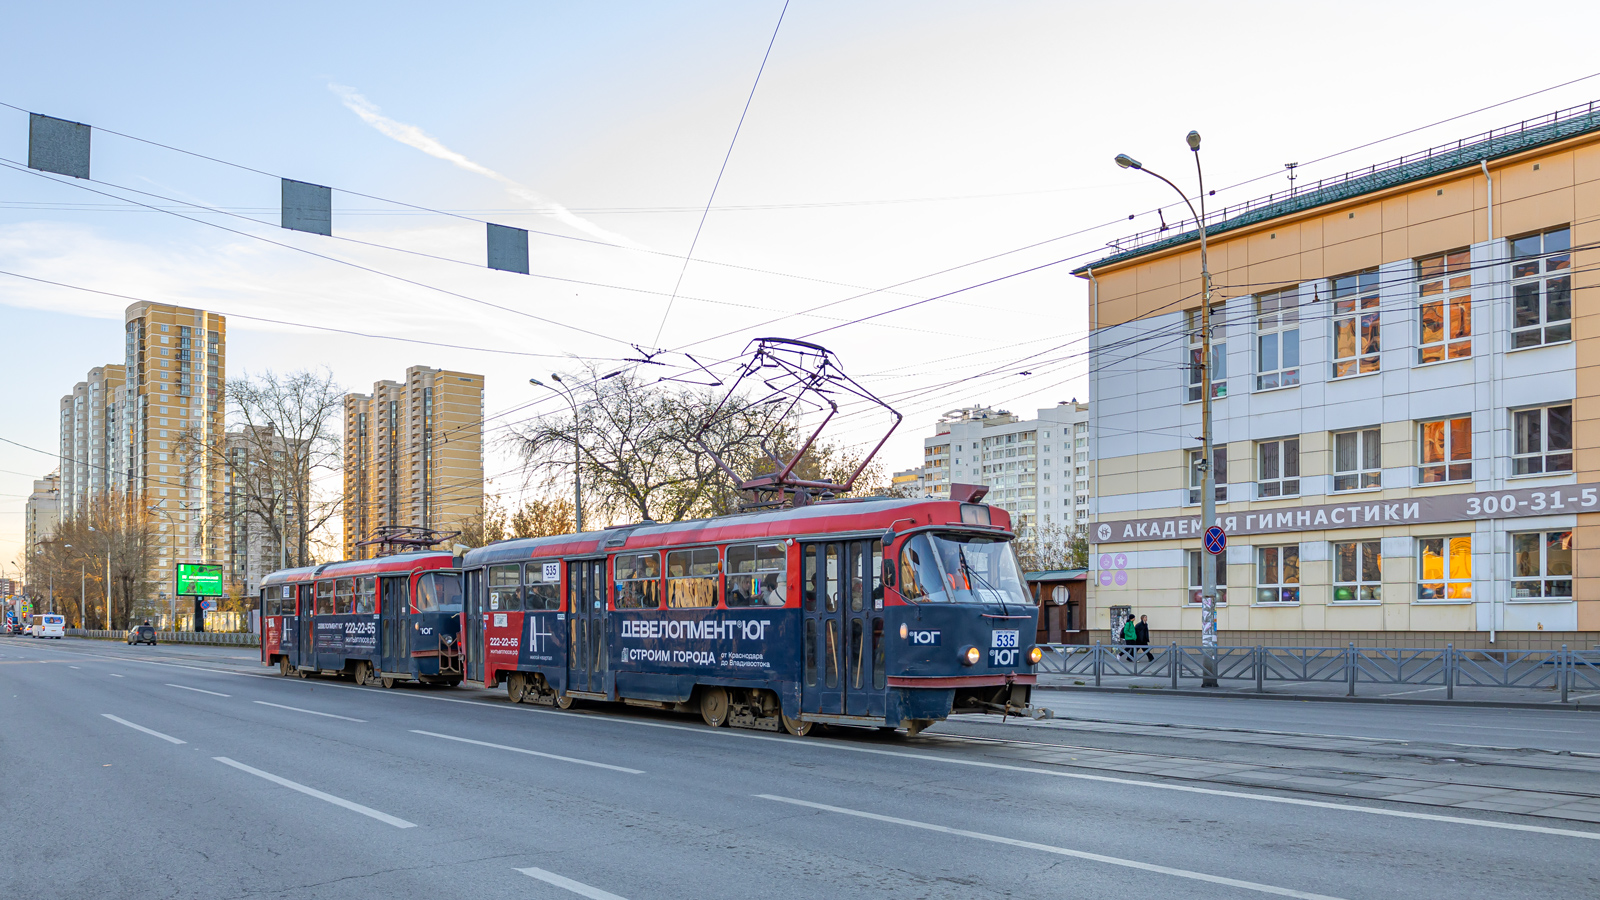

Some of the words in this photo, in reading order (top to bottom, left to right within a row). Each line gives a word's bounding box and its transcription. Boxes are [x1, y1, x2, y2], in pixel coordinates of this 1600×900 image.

[1466, 487, 1598, 515] 300-31-5
[1122, 516, 1237, 539] АКАДЕМЯ
[1245, 502, 1420, 531] ГИМНАСТИКИ
[545, 564, 557, 576] 535
[345, 622, 376, 634] 222-22-55
[489, 637, 519, 647] 222-22-55
[996, 634, 1015, 647] 535
[629, 649, 671, 662] СТРОИМ
[673, 650, 716, 666] ГОРОДА
[728, 651, 764, 661] Краснодара
[729, 659, 771, 668] Владивостока
